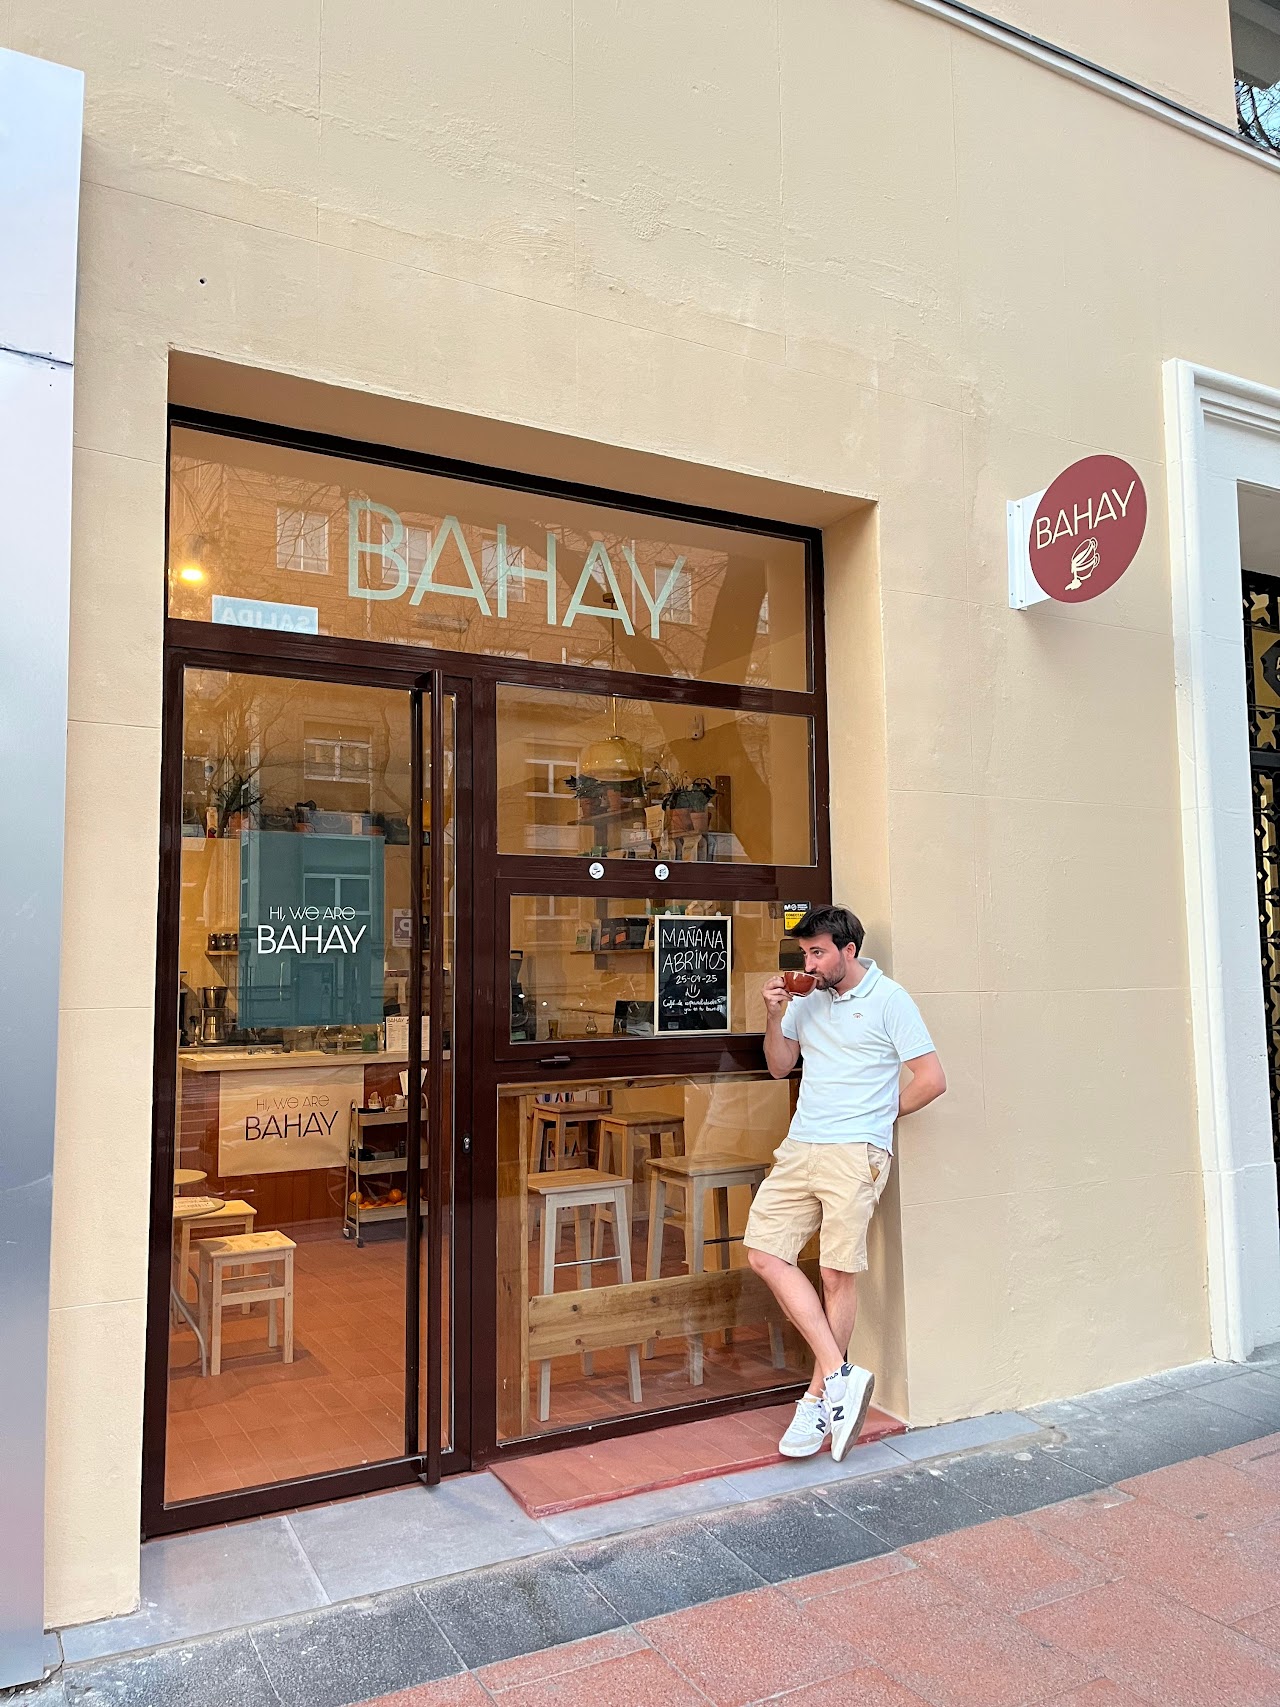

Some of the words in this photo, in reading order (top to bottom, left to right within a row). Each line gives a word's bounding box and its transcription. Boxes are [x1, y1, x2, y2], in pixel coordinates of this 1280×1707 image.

[1036, 480, 1136, 550] BAHAY
[347, 499, 688, 640] BAHAY
[257, 924, 367, 954] BAHAY
[662, 925, 724, 949] MAÑANA
[662, 949, 727, 974] ABRIMOS
[245, 1110, 338, 1141] BAHAY
